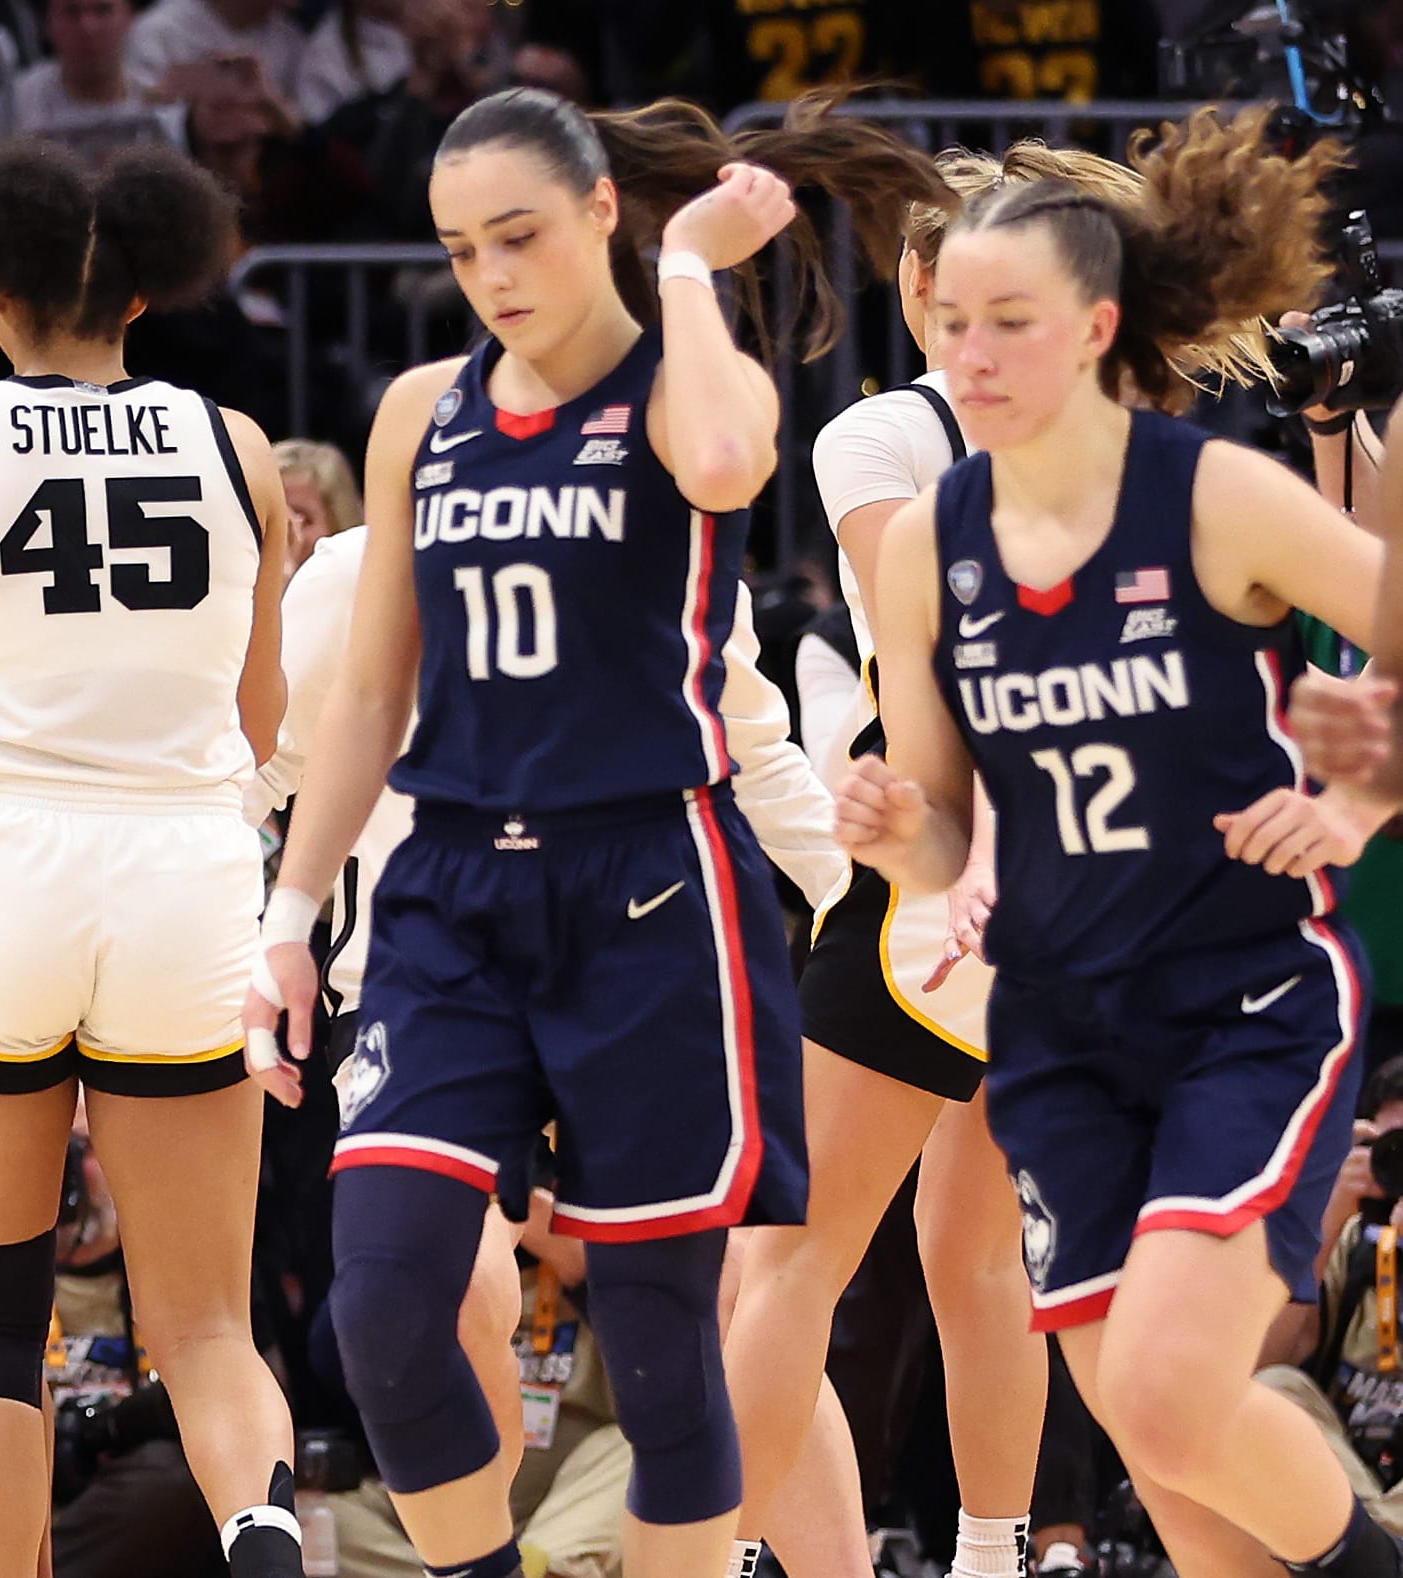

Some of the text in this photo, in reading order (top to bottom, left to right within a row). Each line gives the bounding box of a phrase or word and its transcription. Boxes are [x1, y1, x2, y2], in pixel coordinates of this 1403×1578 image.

[10, 404, 178, 454] STUELKE
[0, 476, 209, 615] 45
[414, 485, 626, 550] UCONN
[453, 563, 558, 680] 10
[958, 650, 1189, 735] UCONN
[1030, 742, 1150, 855] 12
